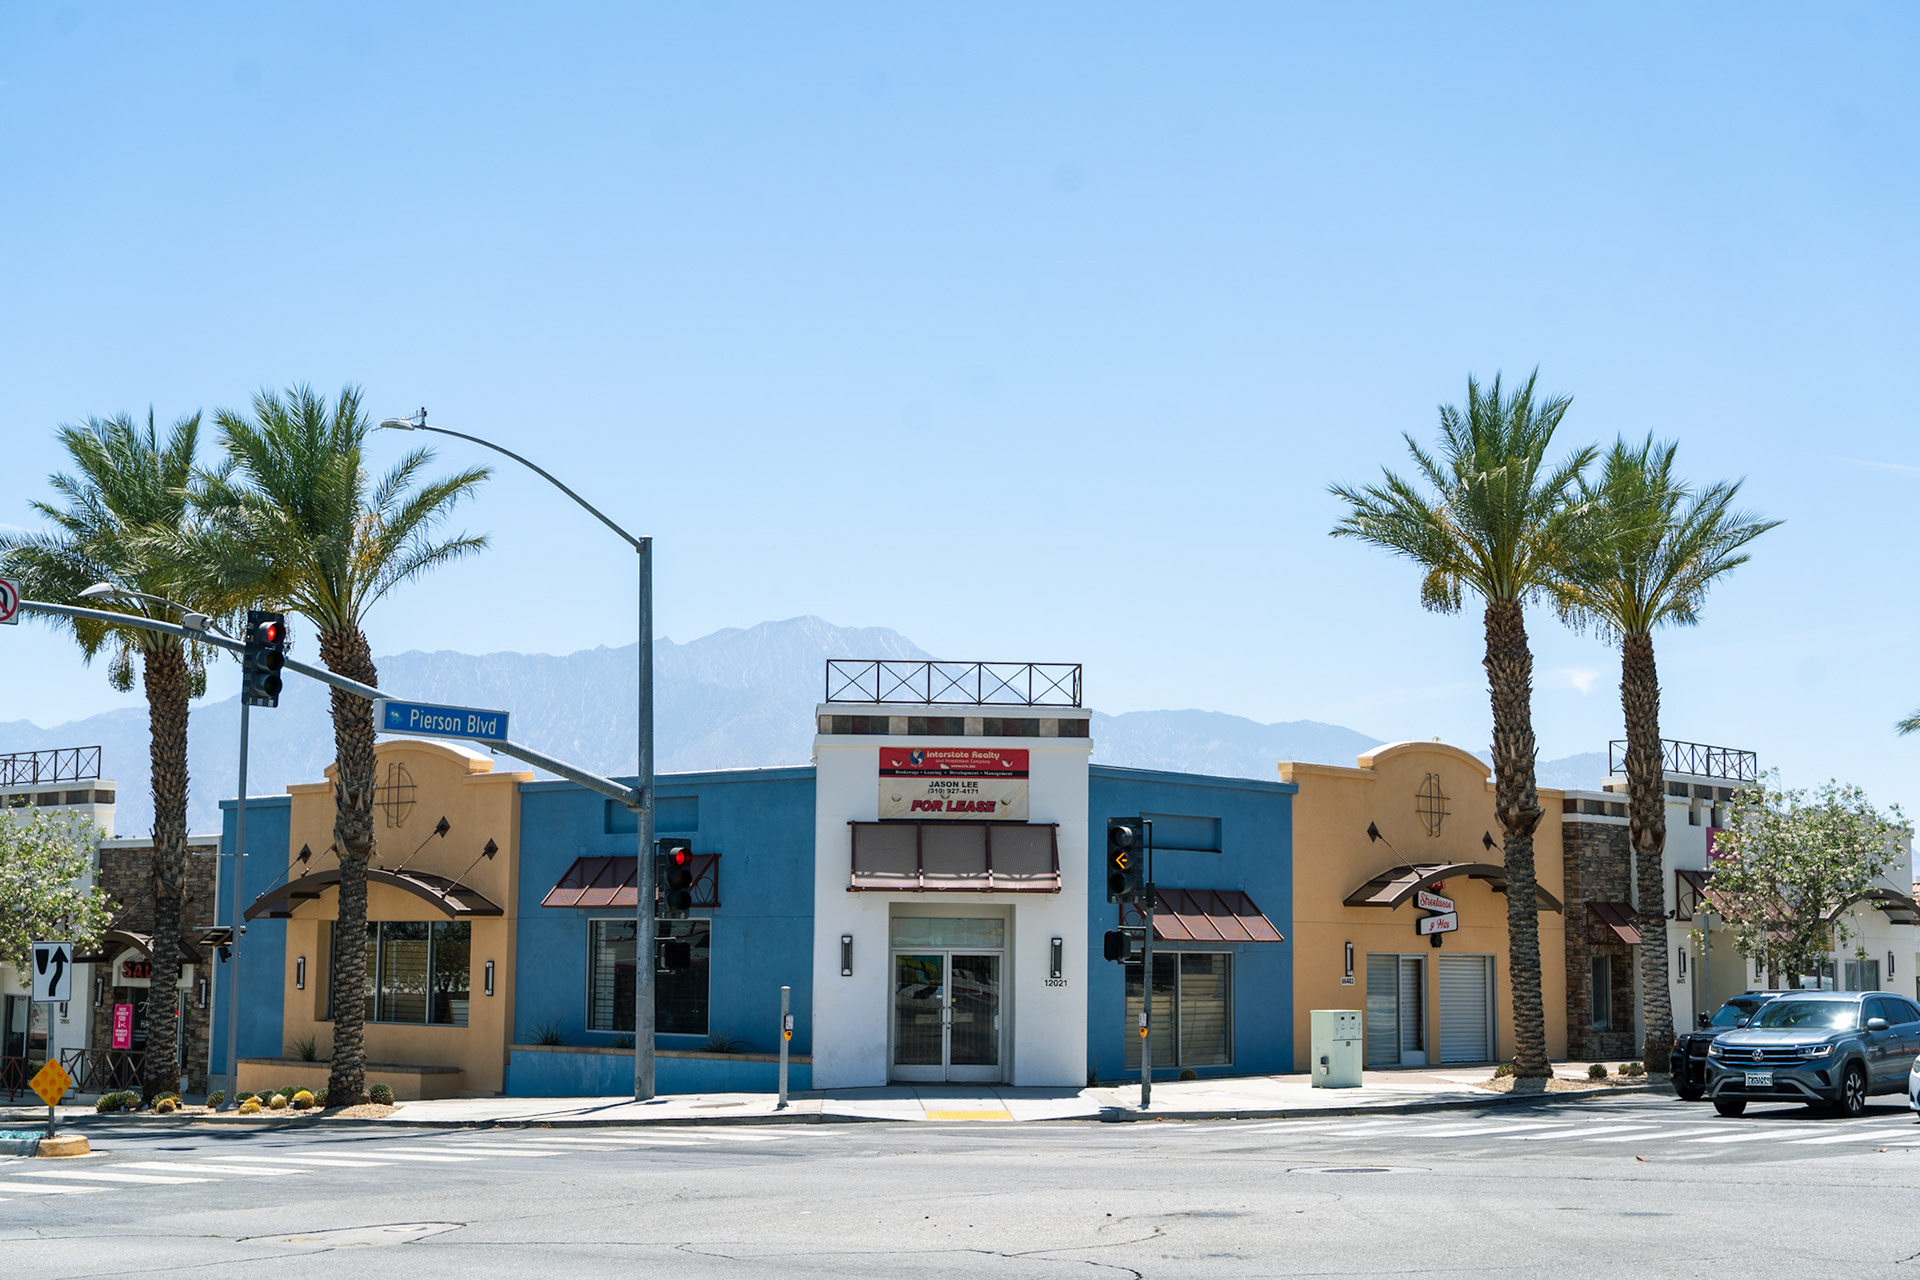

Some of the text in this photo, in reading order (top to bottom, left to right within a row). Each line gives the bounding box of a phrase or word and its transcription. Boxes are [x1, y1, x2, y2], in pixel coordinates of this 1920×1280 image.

[409, 709, 497, 735] Pierson Blvd
[926, 750, 1000, 760] Interstate Realty
[911, 800, 997, 813] FOR LEASE
[1044, 979, 1068, 987] 12021
